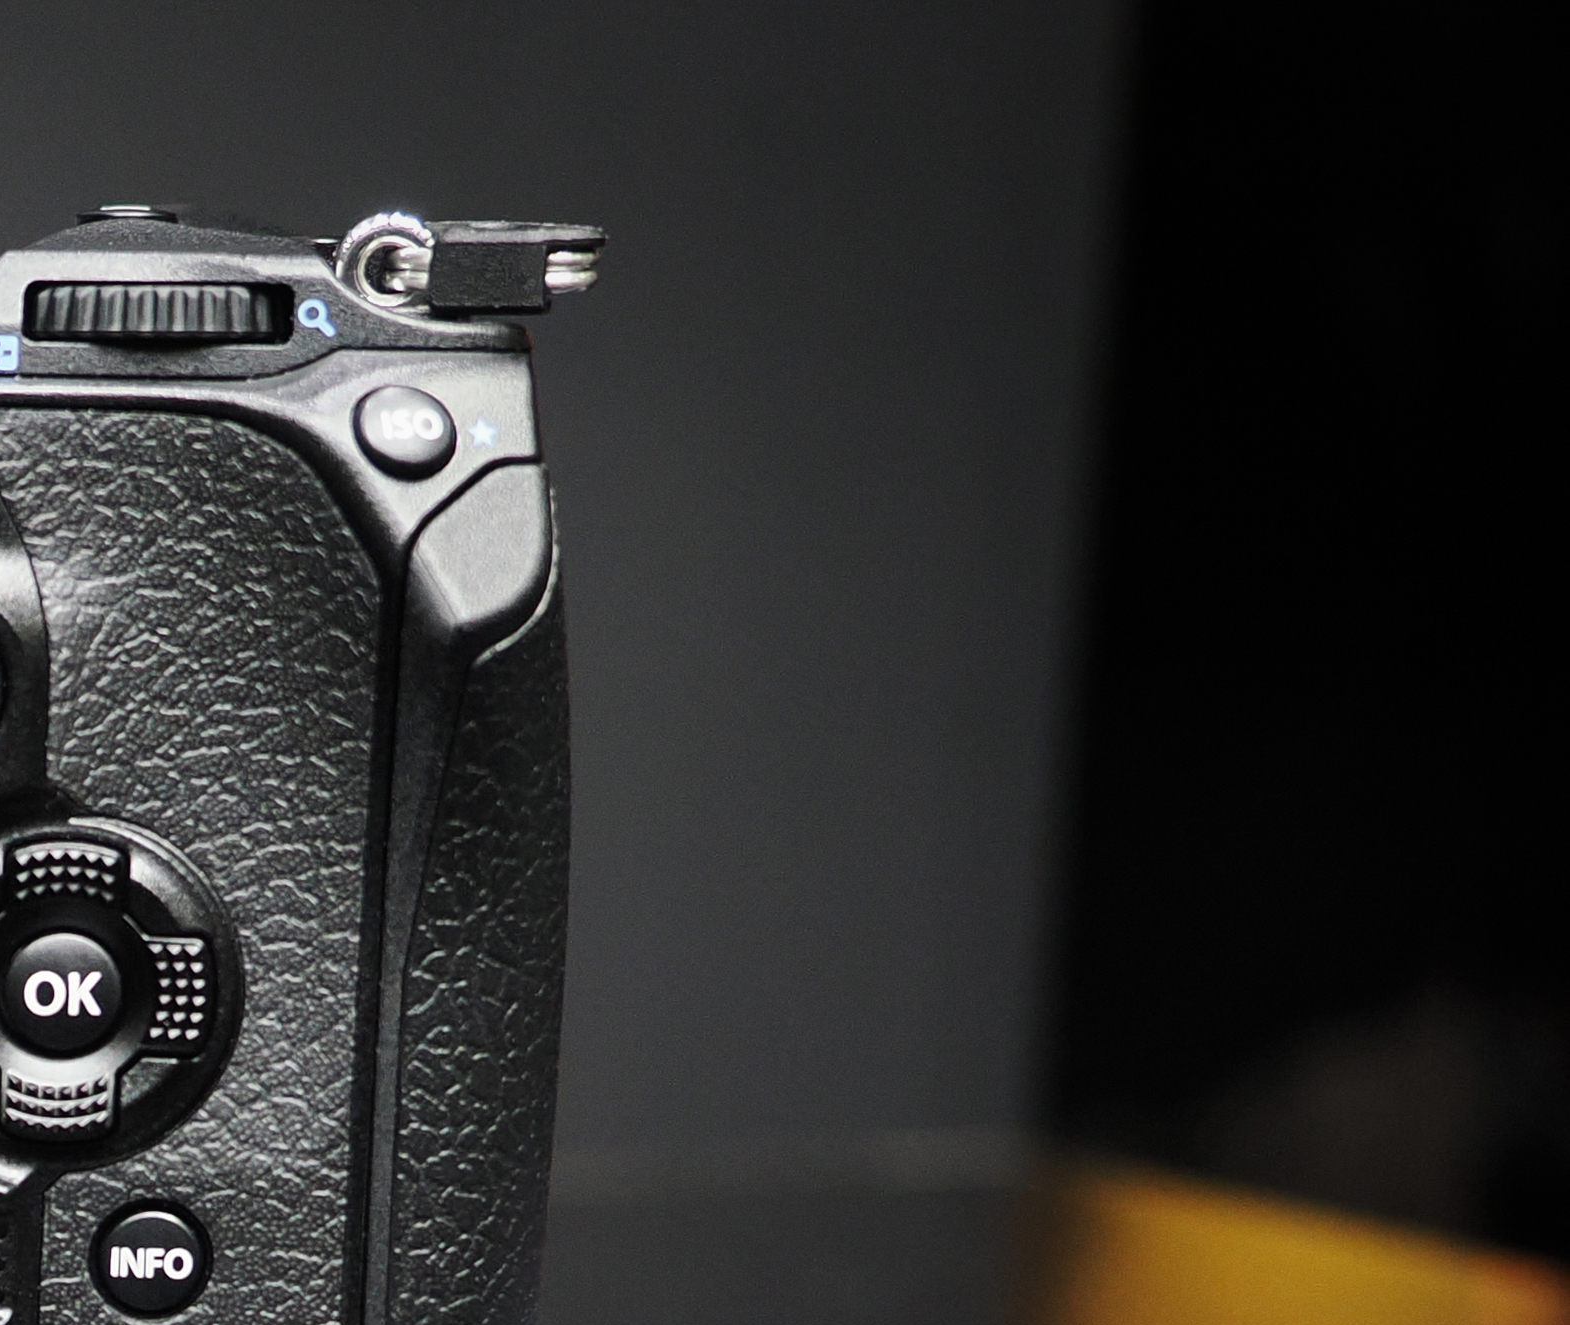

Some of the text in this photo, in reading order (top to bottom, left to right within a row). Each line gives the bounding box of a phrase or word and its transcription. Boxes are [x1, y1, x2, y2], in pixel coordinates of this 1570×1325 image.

[380, 410, 444, 441] ISO
[22, 970, 103, 1019] OK
[108, 1245, 195, 1281] INFO
